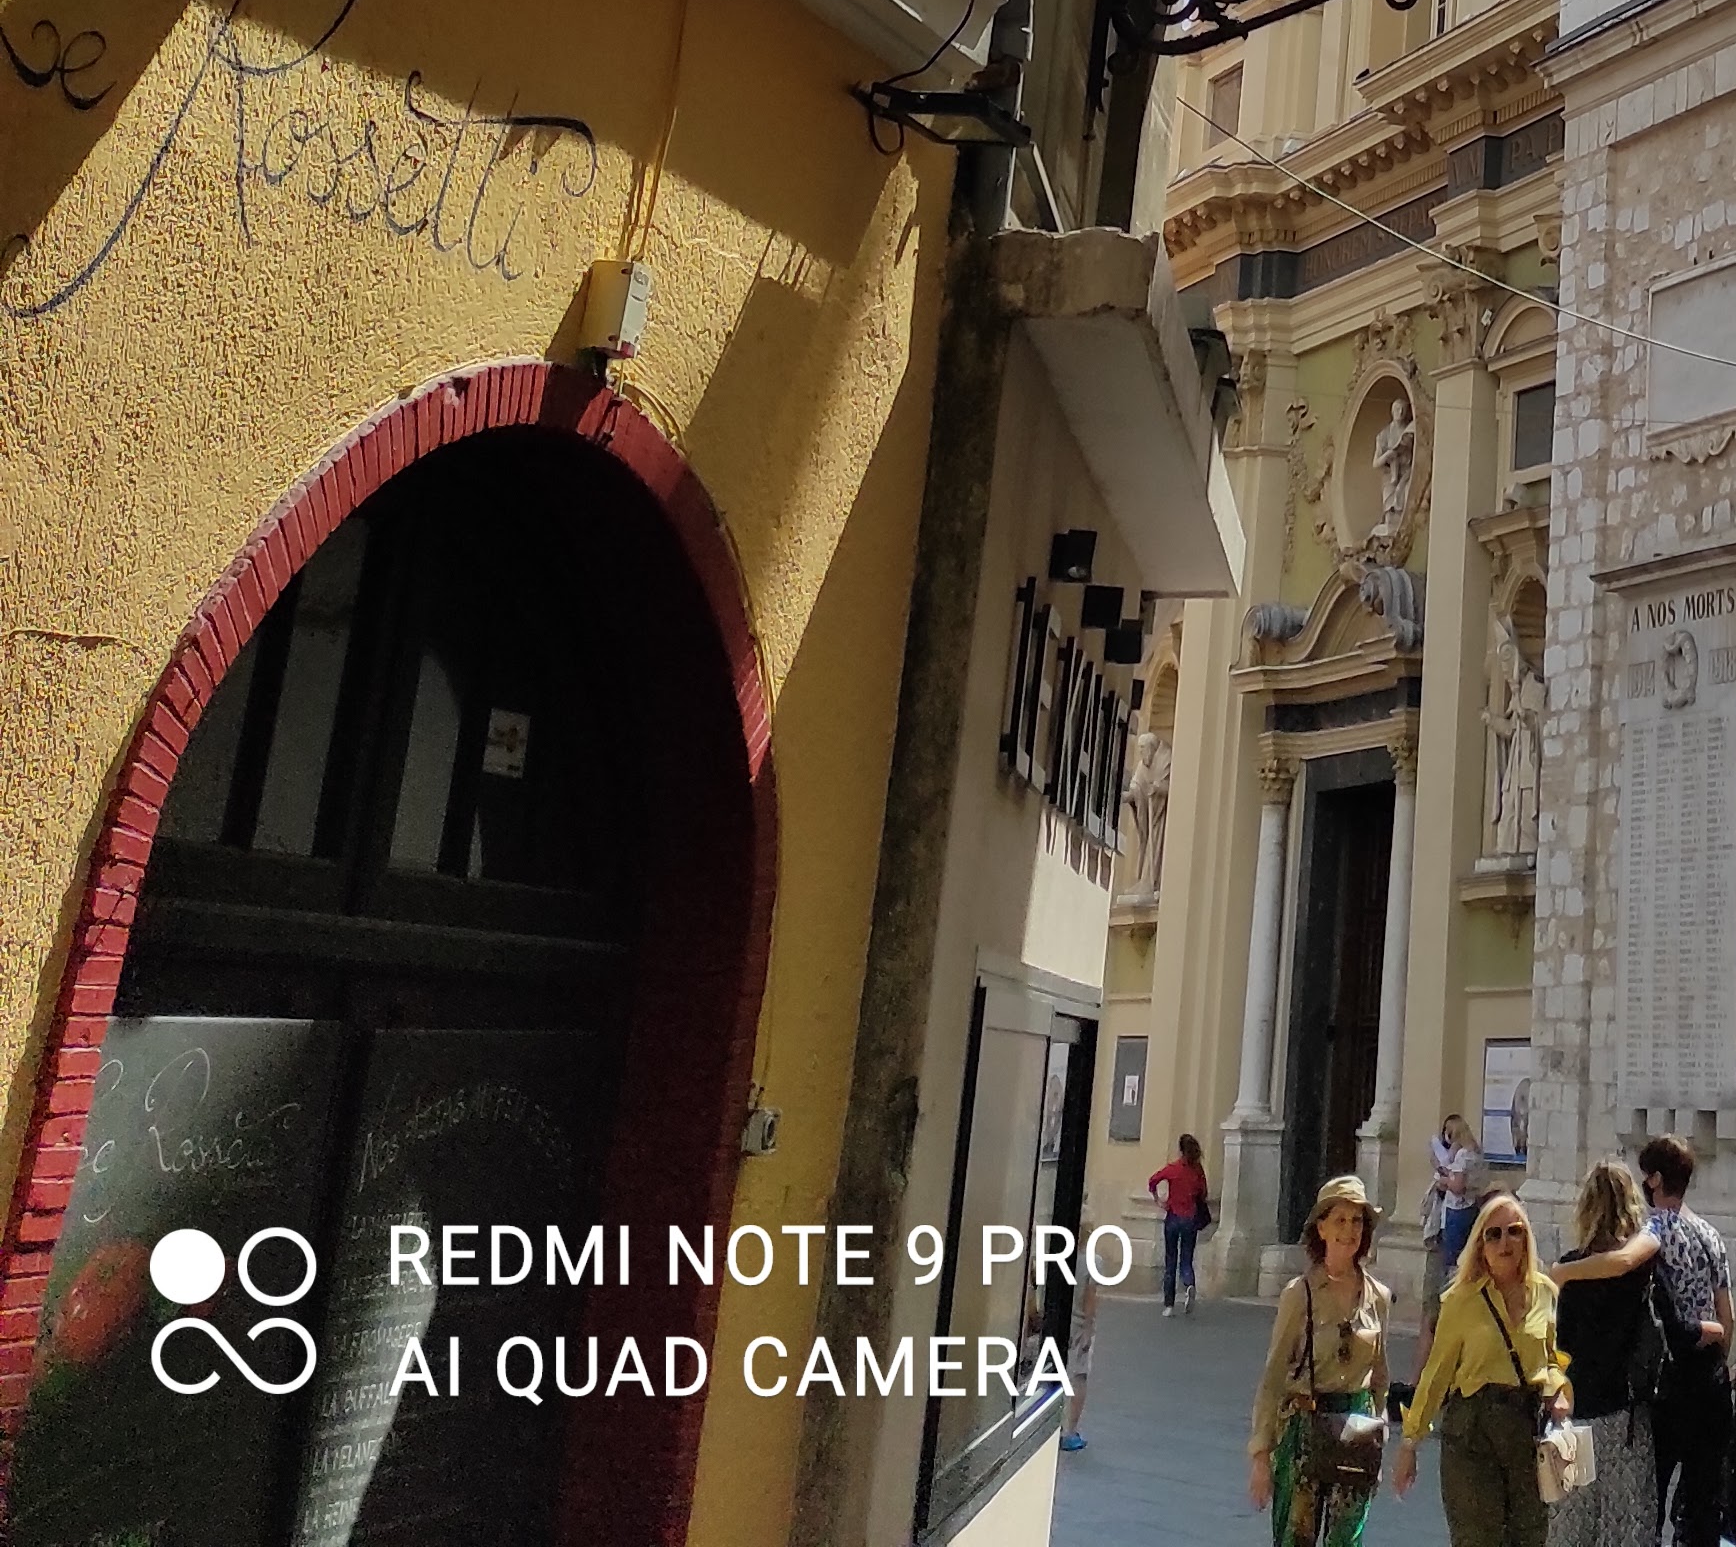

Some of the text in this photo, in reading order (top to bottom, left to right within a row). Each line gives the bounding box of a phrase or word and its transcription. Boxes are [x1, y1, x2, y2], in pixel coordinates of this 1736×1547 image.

[1630, 587, 1736, 634] A NOS MORTS
